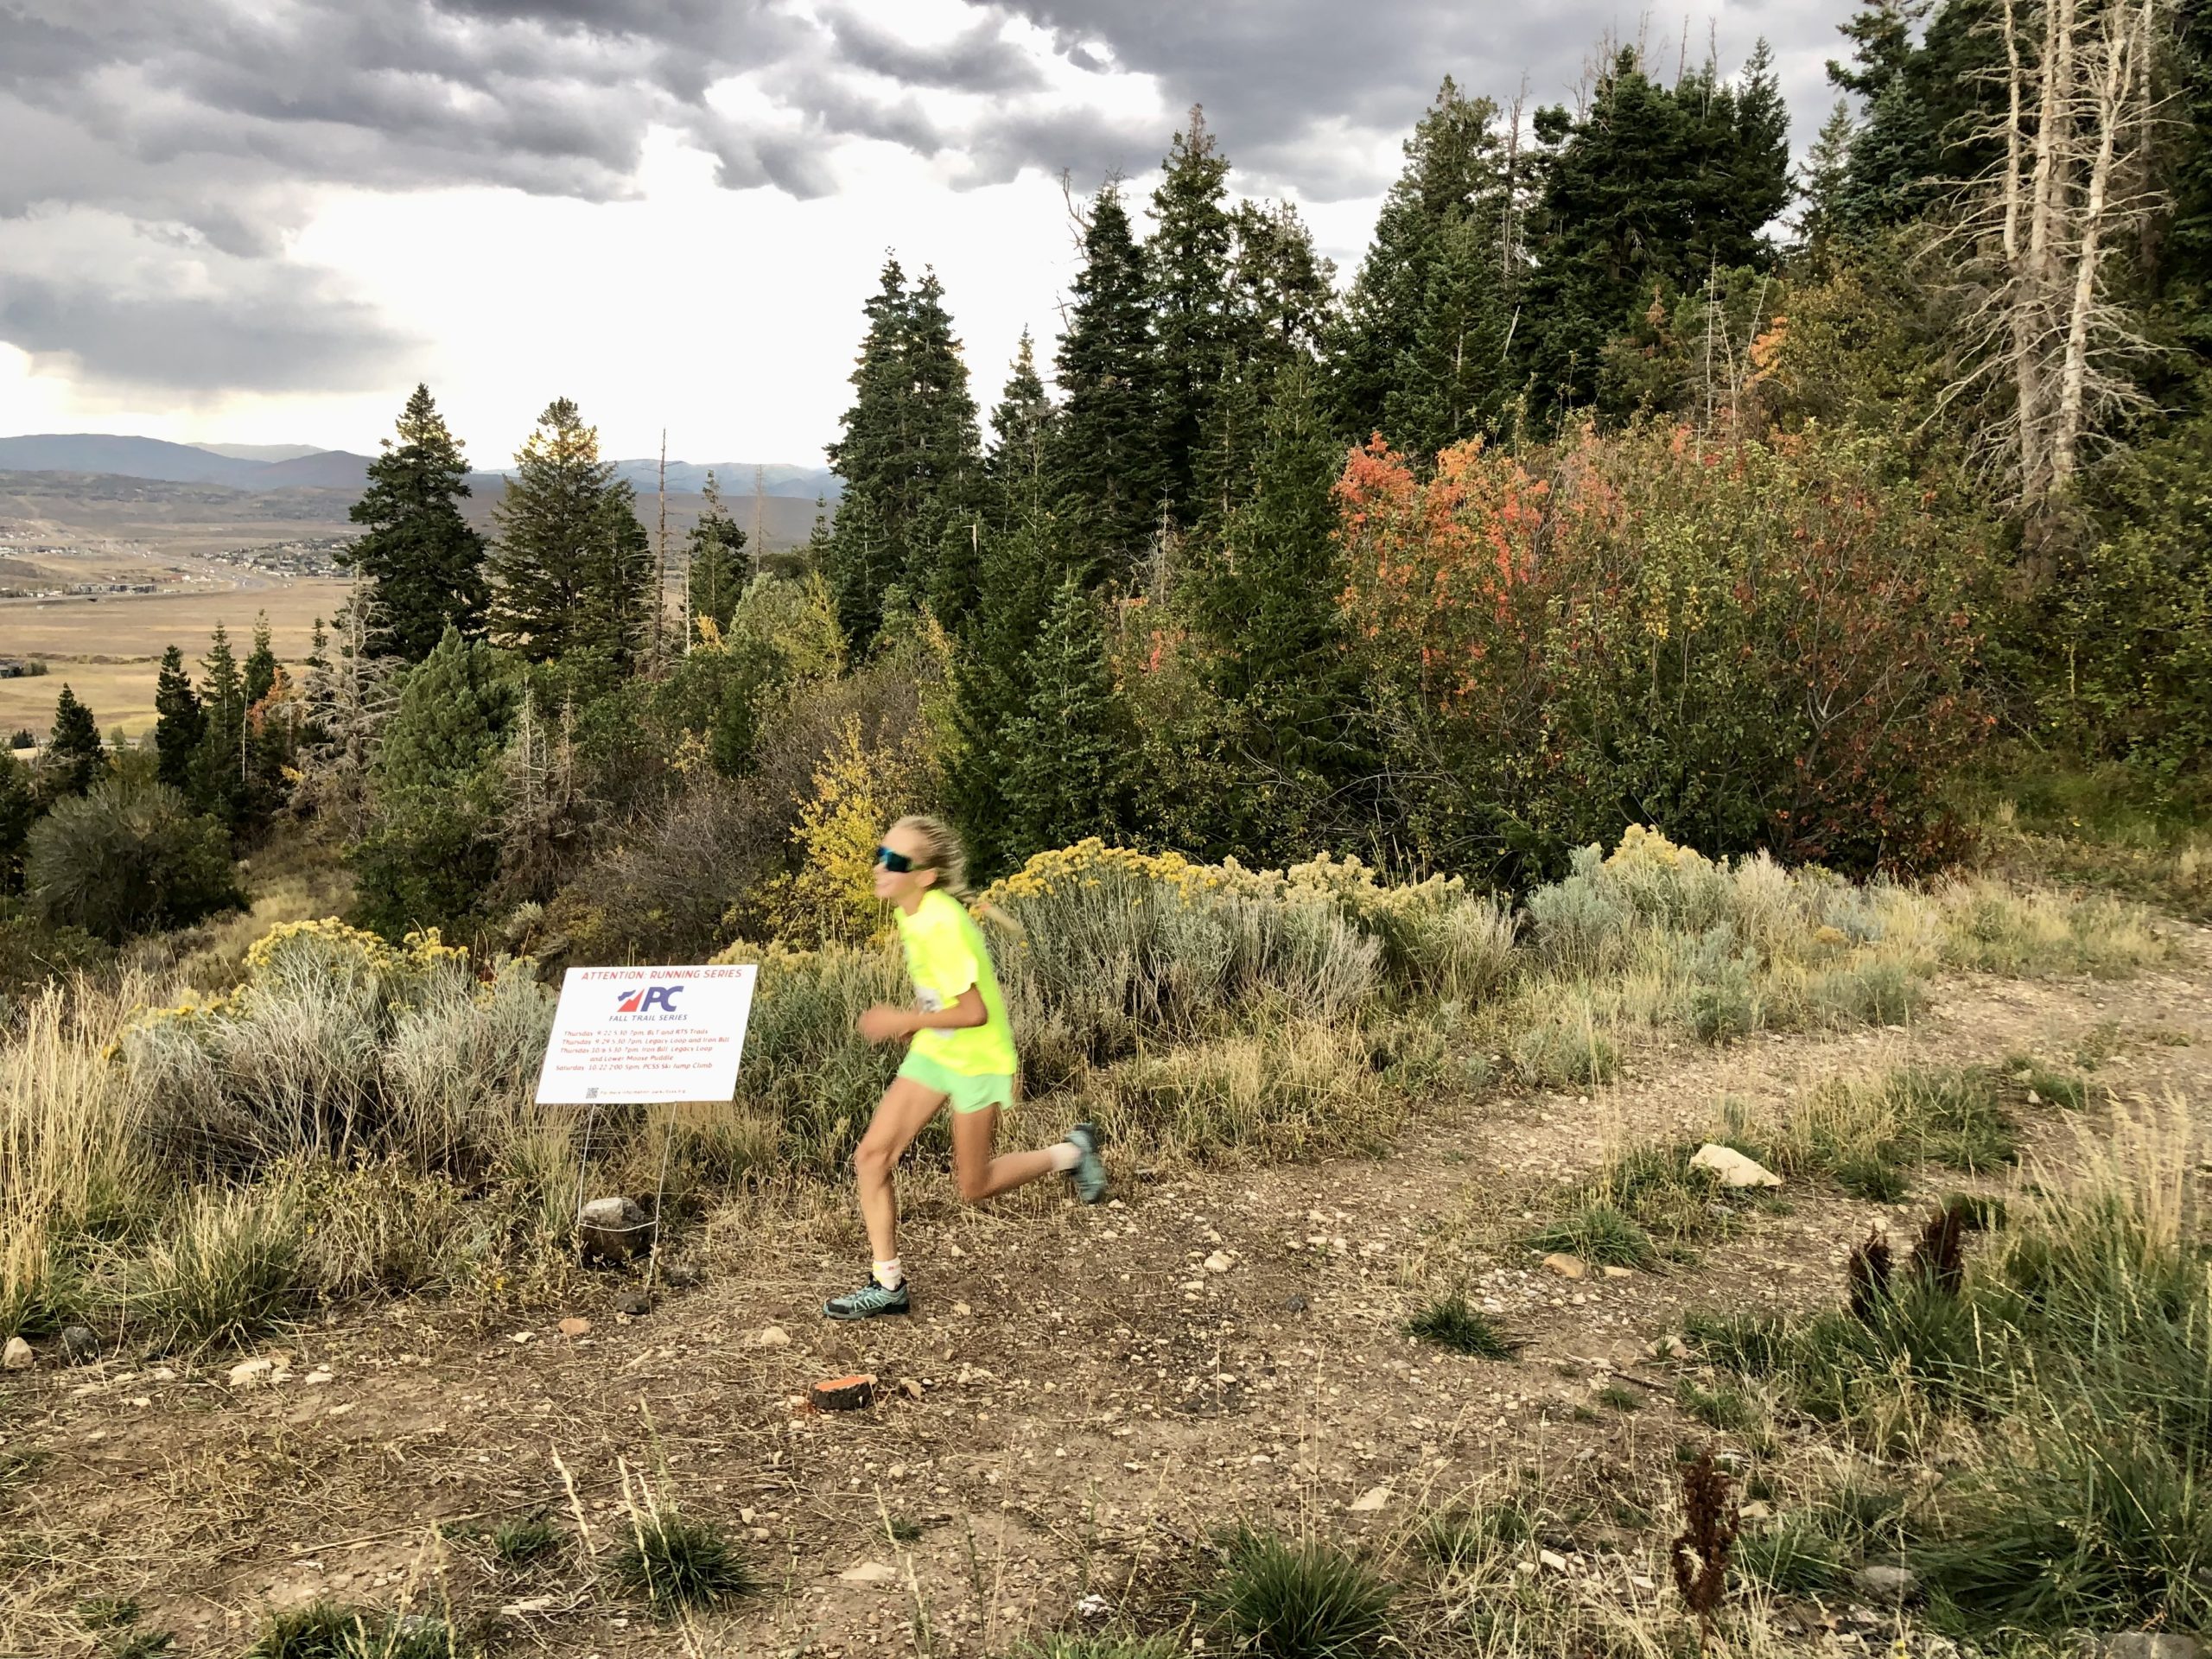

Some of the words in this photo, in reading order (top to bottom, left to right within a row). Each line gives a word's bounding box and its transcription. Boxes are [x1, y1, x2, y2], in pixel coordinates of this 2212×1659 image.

[582, 971, 647, 980] ATTENTION:
[650, 970, 700, 979] RUNNING
[704, 969, 742, 978] SERIES
[640, 986, 684, 1012] PC
